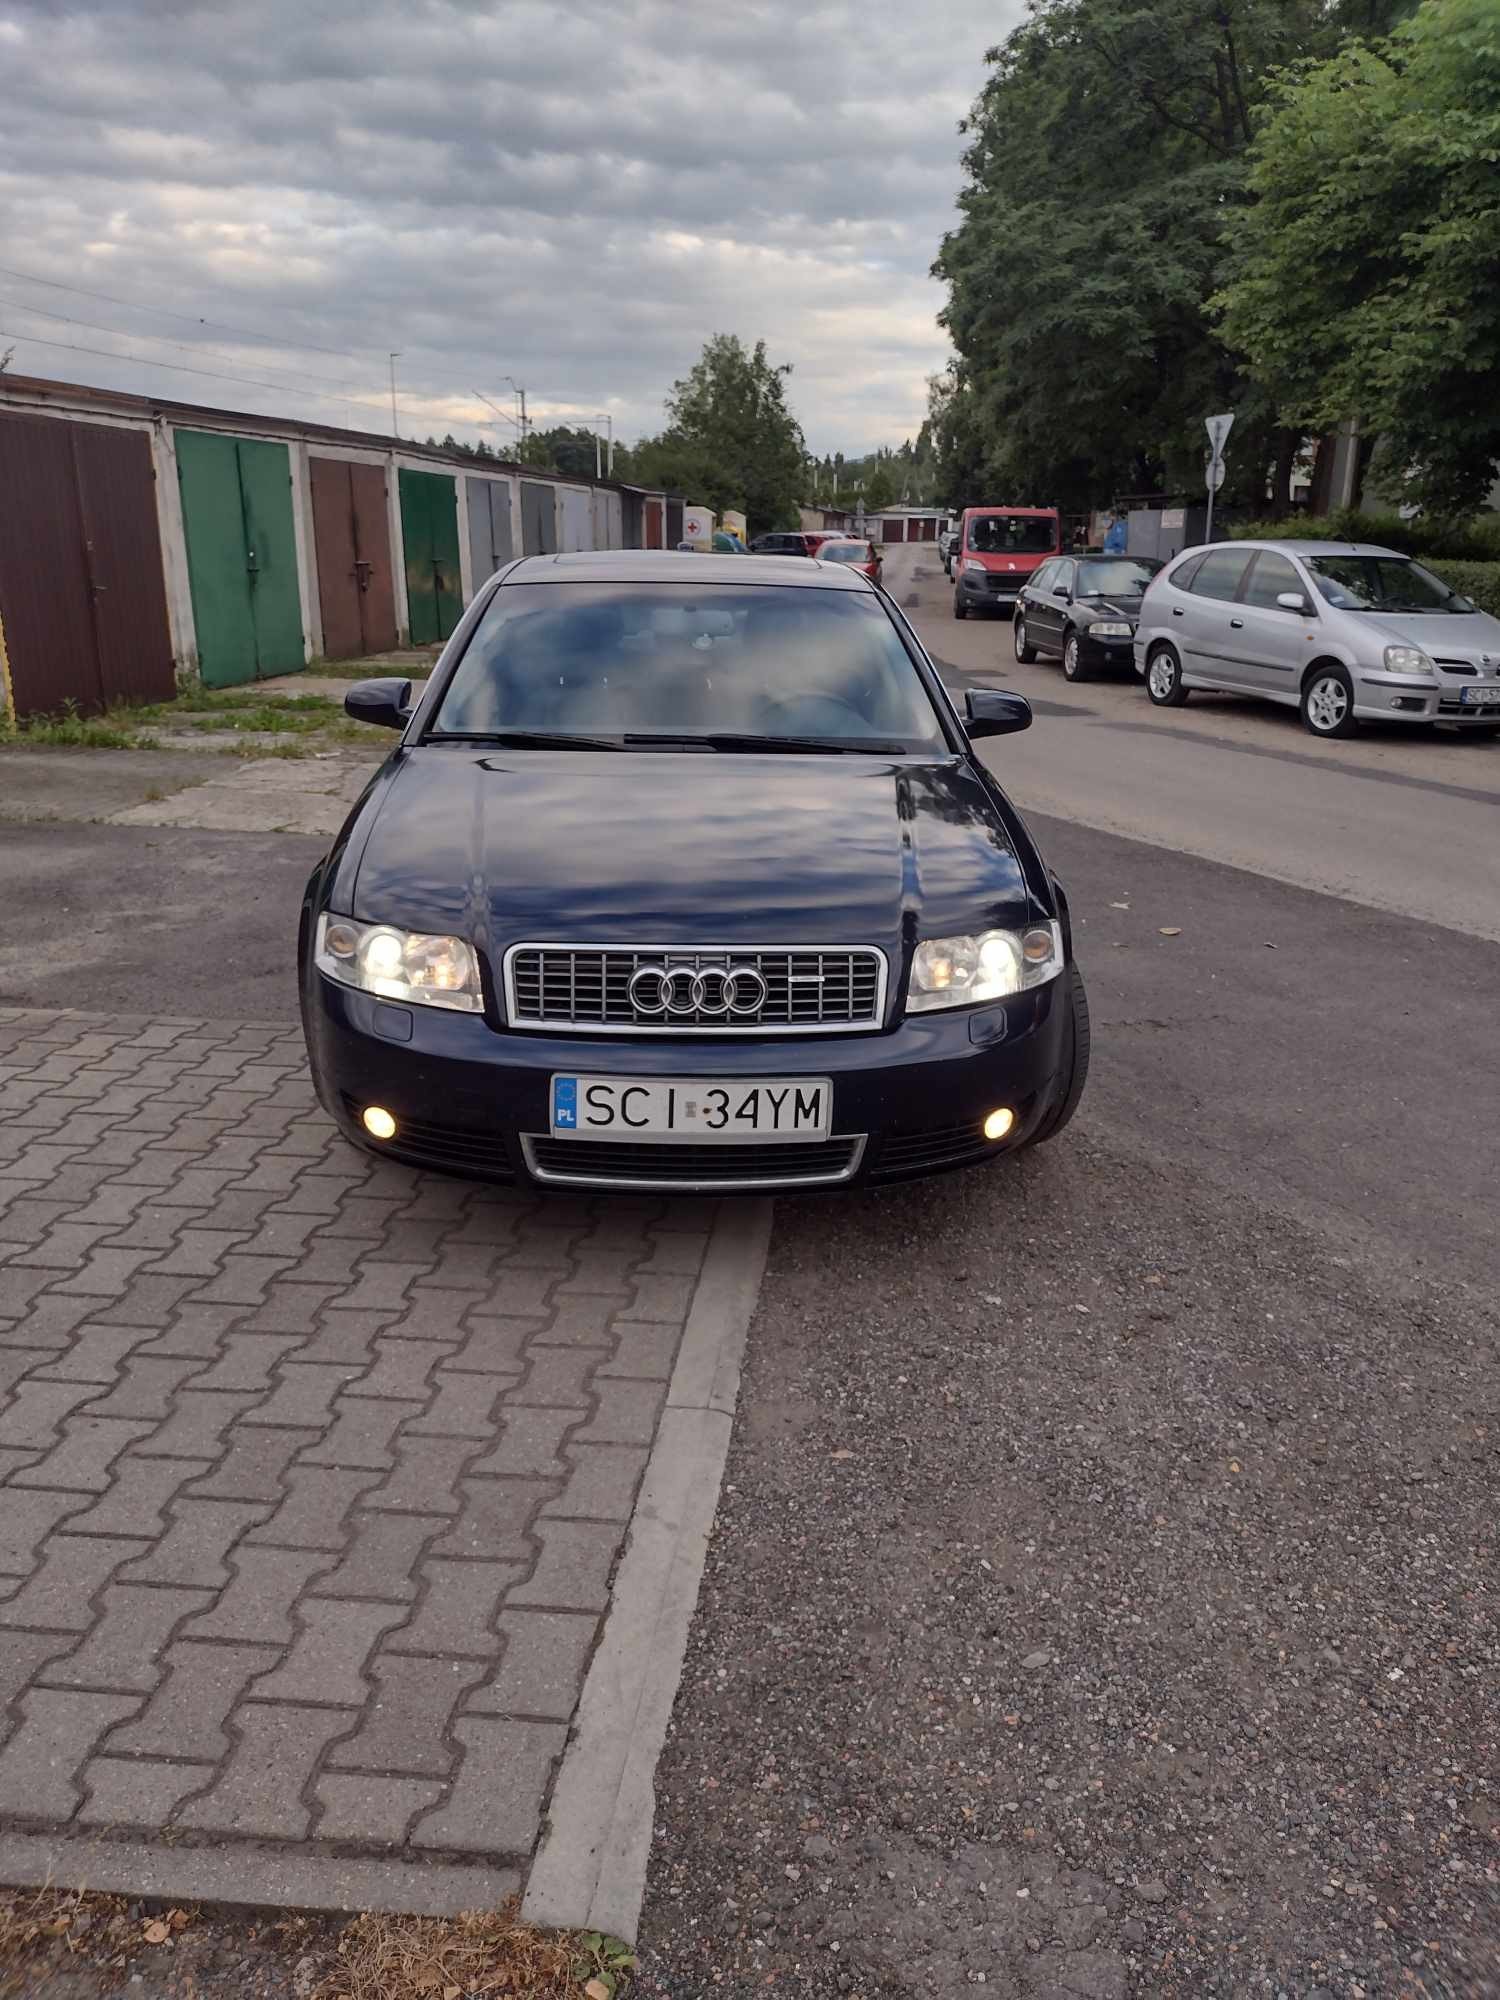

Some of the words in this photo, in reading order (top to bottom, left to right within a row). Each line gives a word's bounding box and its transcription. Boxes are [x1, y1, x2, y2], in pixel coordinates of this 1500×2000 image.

[557, 1108, 575, 1122] PL
[586, 1085, 675, 1129] SCI
[706, 1088, 821, 1129] 34YM
